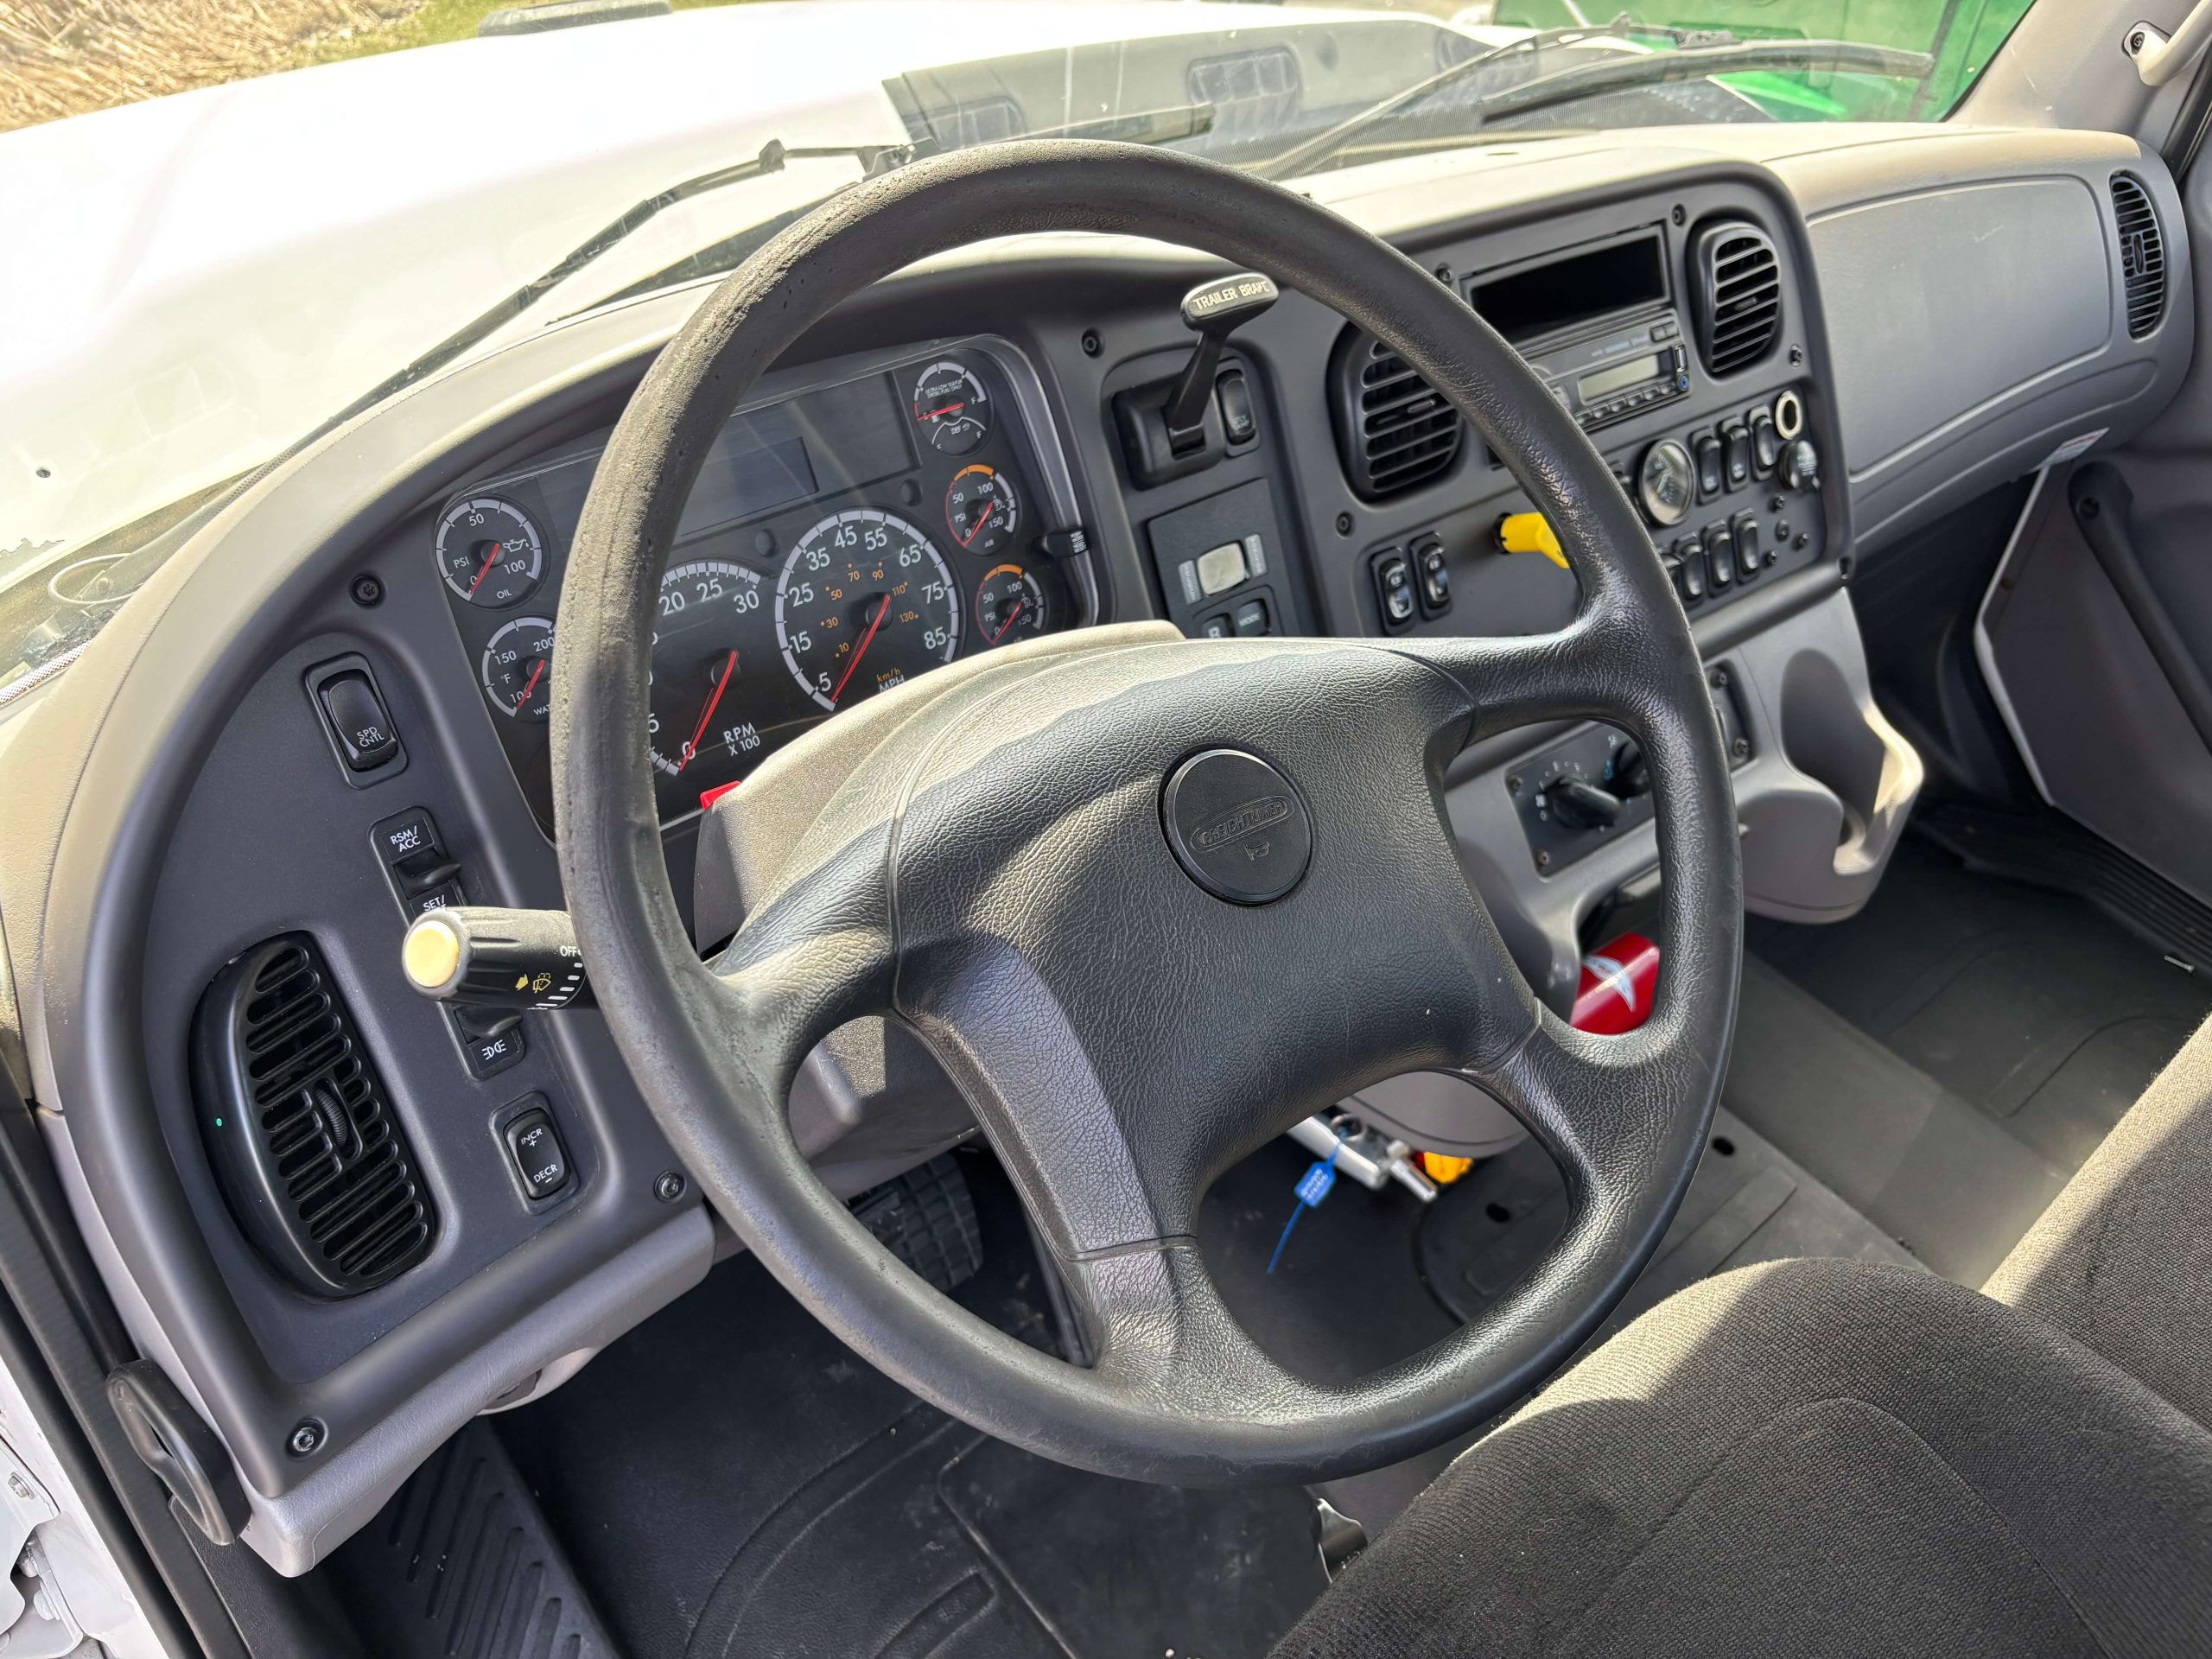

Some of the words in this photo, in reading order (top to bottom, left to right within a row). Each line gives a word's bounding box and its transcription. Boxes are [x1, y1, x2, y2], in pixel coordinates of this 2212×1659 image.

[1192, 287, 1239, 311] TRAILER
[977, 482, 994, 496] 100
[952, 493, 964, 505] 50
[468, 513, 485, 527] 50
[954, 512, 967, 524] PSI
[988, 517, 1004, 531] 150
[835, 525, 857, 549] 45
[864, 527, 887, 550] 55
[453, 556, 470, 569] PSI
[806, 547, 830, 571] 35
[899, 543, 922, 567] 65
[504, 559, 526, 575] 100
[872, 569, 884, 581] 90
[848, 570, 861, 582] 70
[496, 588, 512, 600] OIL
[696, 578, 723, 602] 25
[789, 582, 814, 607] 25
[830, 588, 842, 601] 50
[892, 584, 906, 597] 110
[921, 581, 944, 604] 75
[1006, 581, 1022, 594] 100
[658, 591, 685, 616] 20
[734, 590, 760, 613] 30
[982, 592, 994, 605] 50
[826, 616, 839, 628] 30
[899, 610, 914, 622] 130
[984, 612, 996, 623] PSI
[533, 637, 555, 652] 200
[790, 631, 812, 653] 15
[924, 626, 947, 650] 85
[838, 641, 849, 653] 10
[494, 650, 517, 666] 150
[819, 671, 831, 691] 5
[876, 667, 900, 683] km/h
[879, 674, 906, 692] MPH
[357, 727, 378, 740] SPD
[359, 733, 385, 747] CNTL
[723, 721, 756, 744] RPM
[682, 741, 696, 760] 0
[740, 734, 760, 752] 100
[390, 825, 417, 845] RSM/
[399, 836, 421, 852] ACC
[423, 894, 446, 912] SET/
[560, 945, 577, 957] OFF
[521, 1128, 543, 1146] INCR
[533, 1164, 557, 1184] DECR
